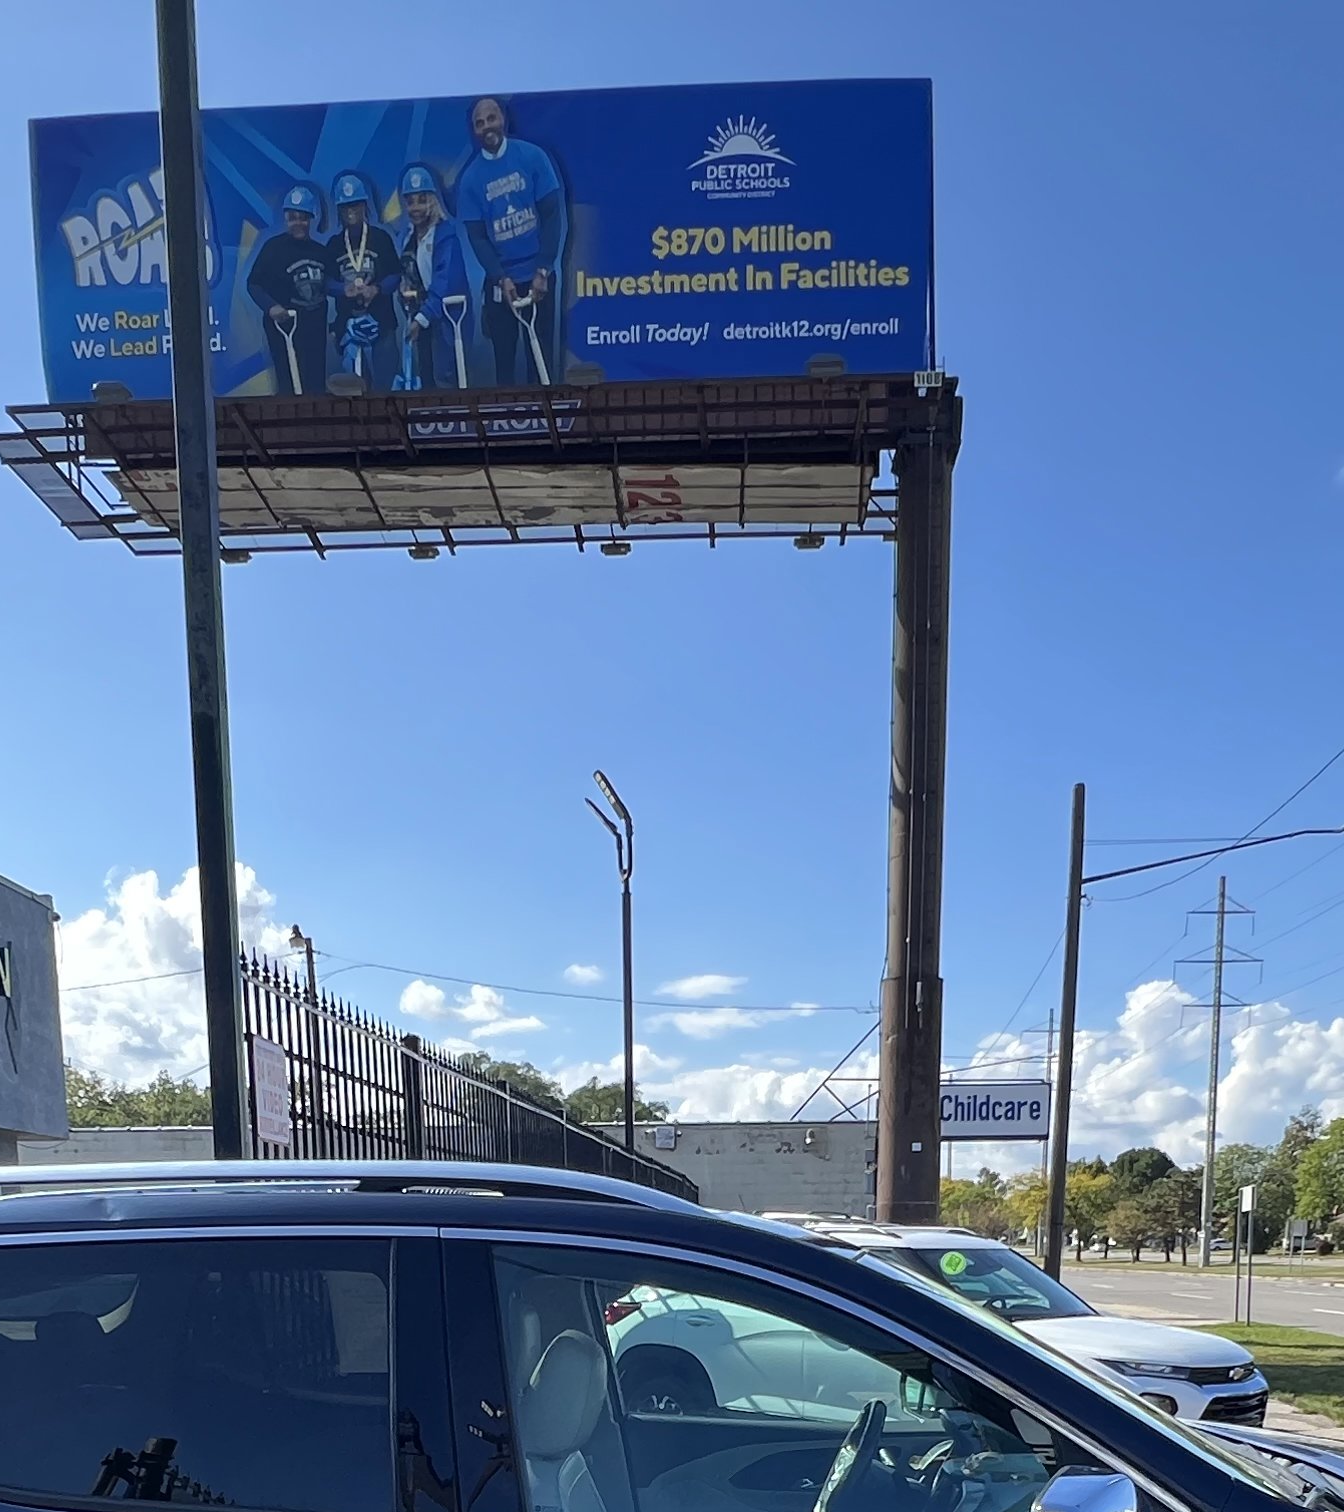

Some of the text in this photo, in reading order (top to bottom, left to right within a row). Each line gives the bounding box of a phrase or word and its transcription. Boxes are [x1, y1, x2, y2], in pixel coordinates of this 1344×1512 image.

[691, 177, 790, 192] PUBLIC SCHOOLS
[706, 163, 776, 180] DETROIT
[652, 223, 832, 260] $870 Million
[576, 259, 910, 298] Investment In Facilities
[75, 312, 110, 333] We
[114, 310, 160, 330] Roar
[586, 318, 900, 347] Enroll Today! detroitk12.org/enroll
[71, 339, 106, 360] We
[109, 335, 158, 357] Lead
[940, 1094, 1042, 1122] Childcare
